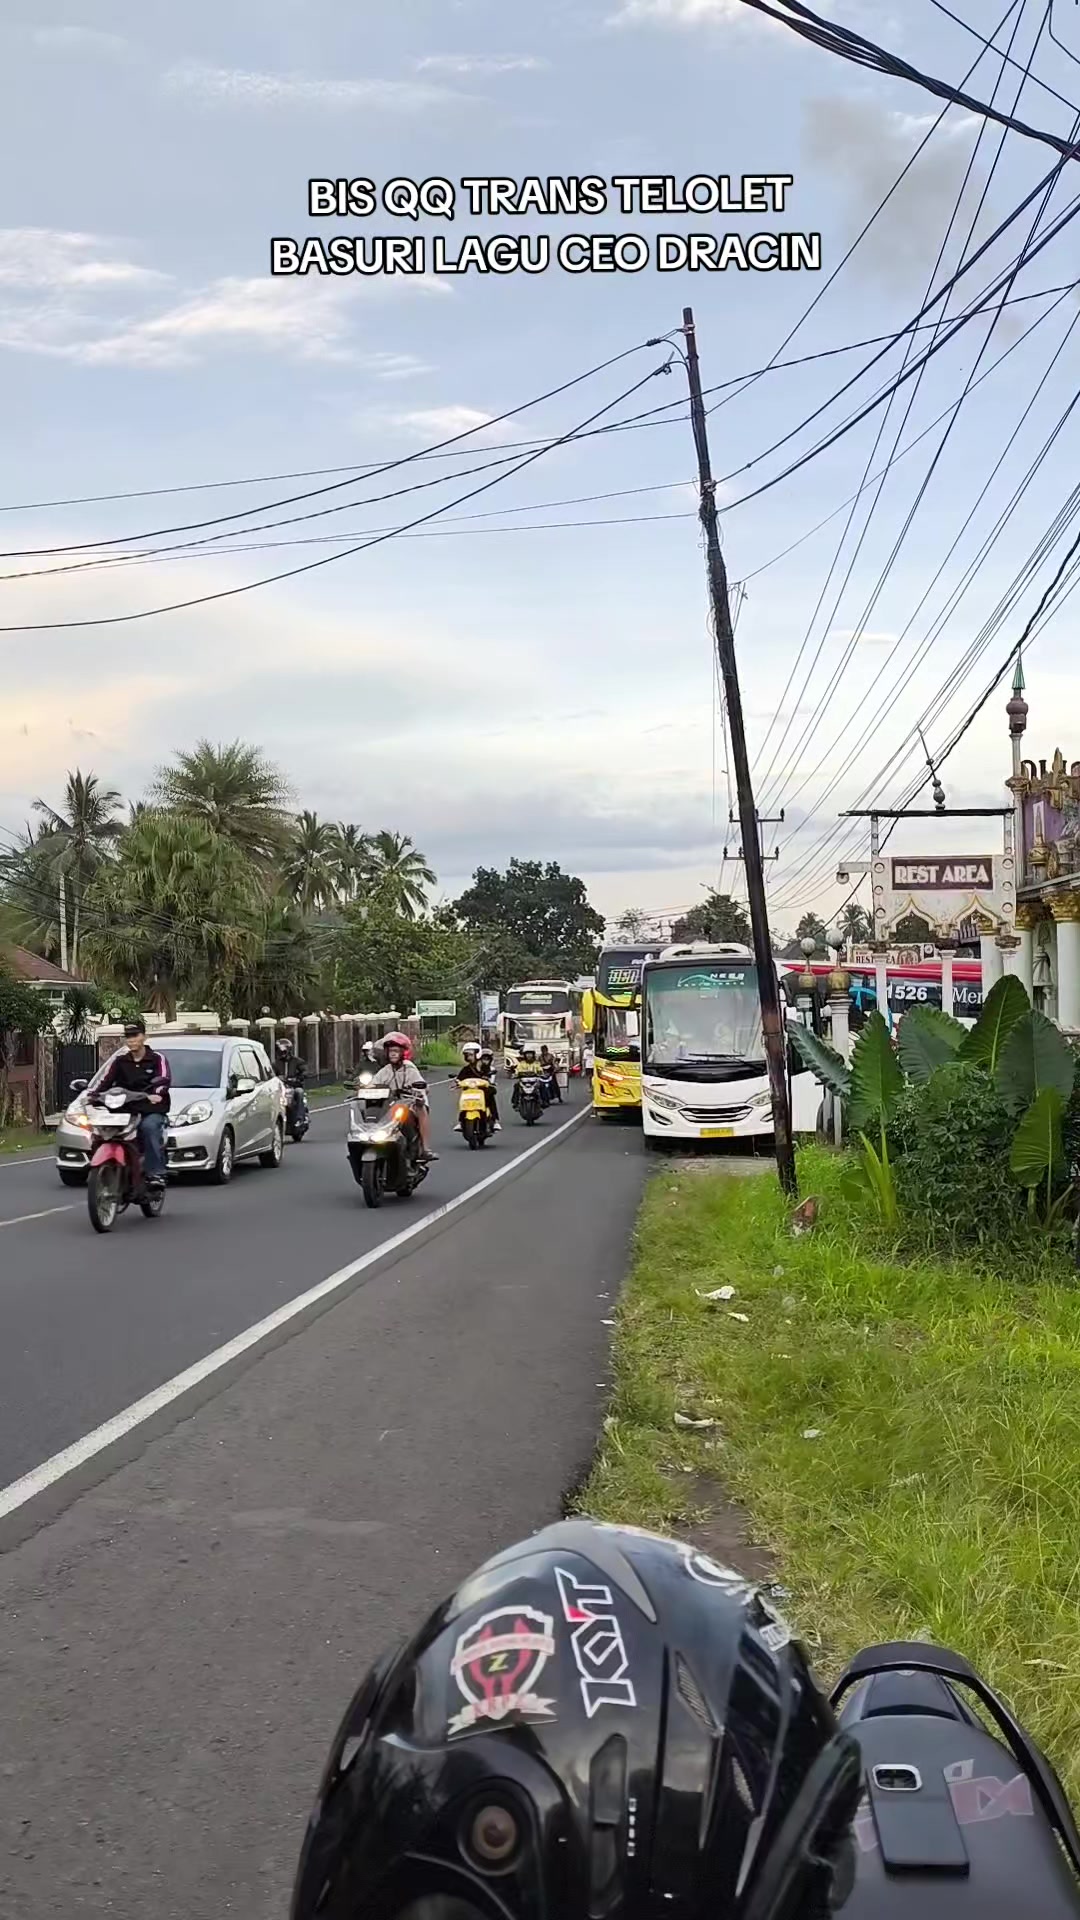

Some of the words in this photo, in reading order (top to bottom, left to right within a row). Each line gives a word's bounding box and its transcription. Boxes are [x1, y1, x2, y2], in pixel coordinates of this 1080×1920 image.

[895, 865, 940, 884] REST
[942, 864, 989, 883] AREA
[886, 983, 928, 1001] 1526
[554, 1566, 637, 1719] KYT
